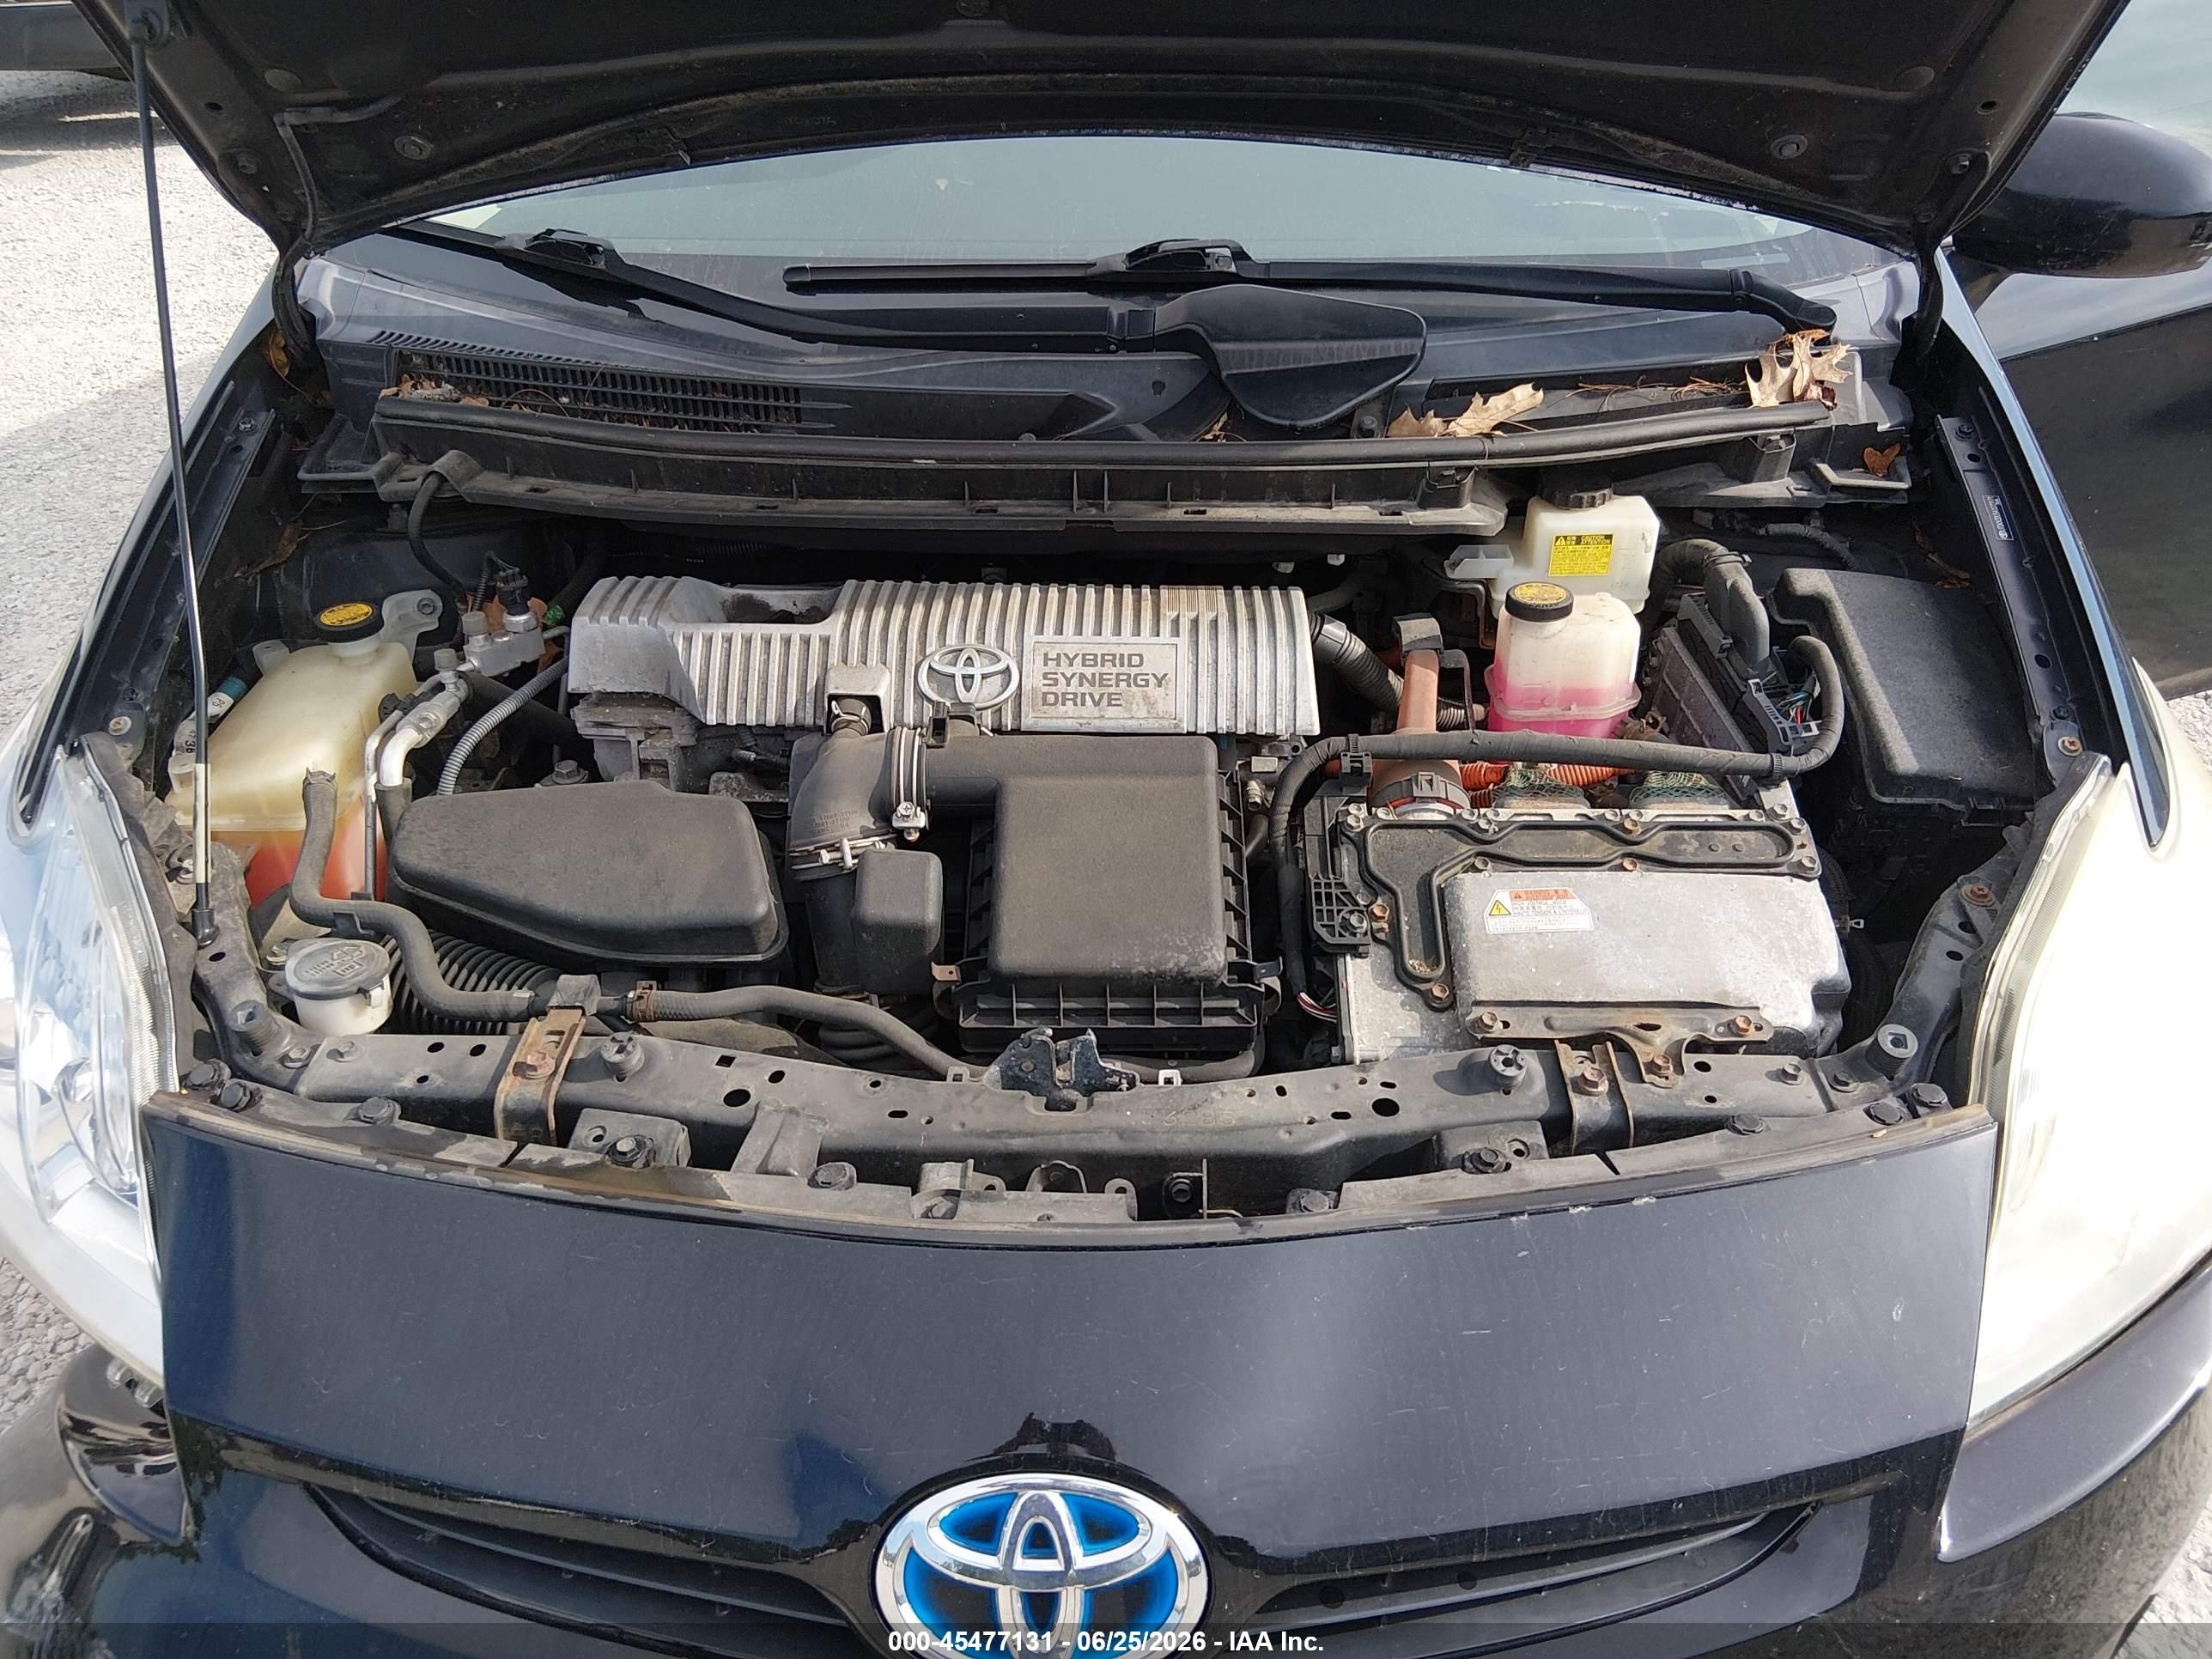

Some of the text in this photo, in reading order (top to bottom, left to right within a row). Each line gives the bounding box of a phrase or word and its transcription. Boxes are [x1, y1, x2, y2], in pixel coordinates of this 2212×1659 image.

[1043, 652, 1145, 668] HYBRID
[1042, 672, 1169, 688] SYNERGY
[1042, 691, 1123, 708] DRIVE
